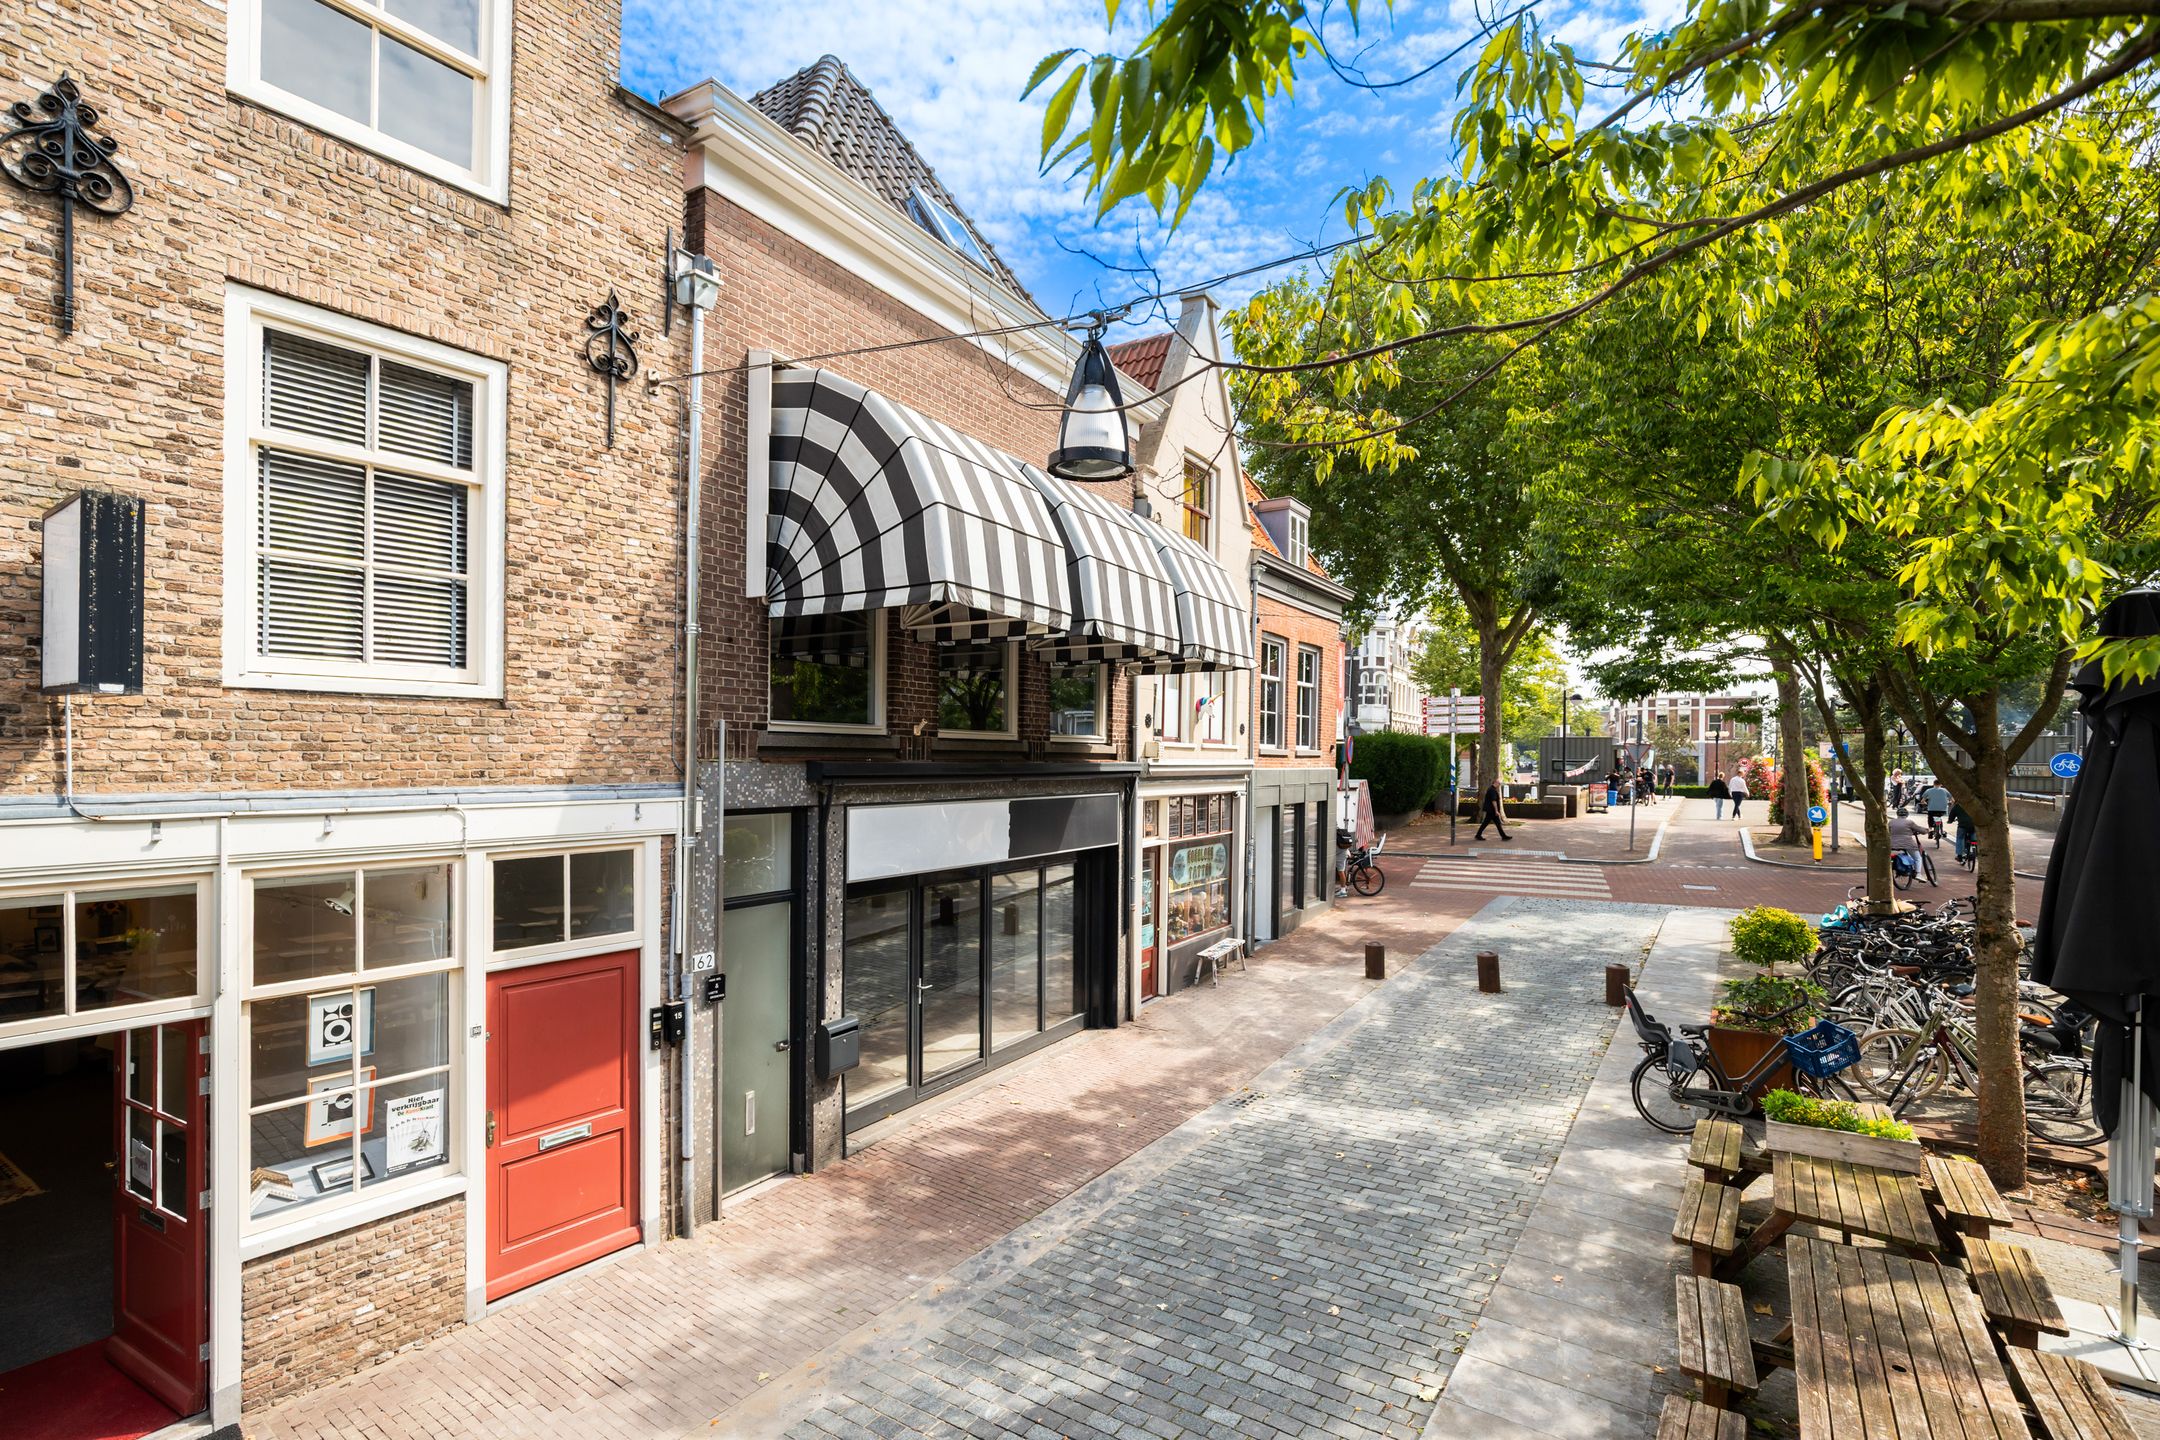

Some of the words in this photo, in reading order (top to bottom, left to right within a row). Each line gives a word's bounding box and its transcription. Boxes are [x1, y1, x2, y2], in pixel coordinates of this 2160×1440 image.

[1189, 863, 1212, 880] TATTOO
[692, 954, 713, 970] 162
[391, 1097, 440, 1112] verkrijgbaar
